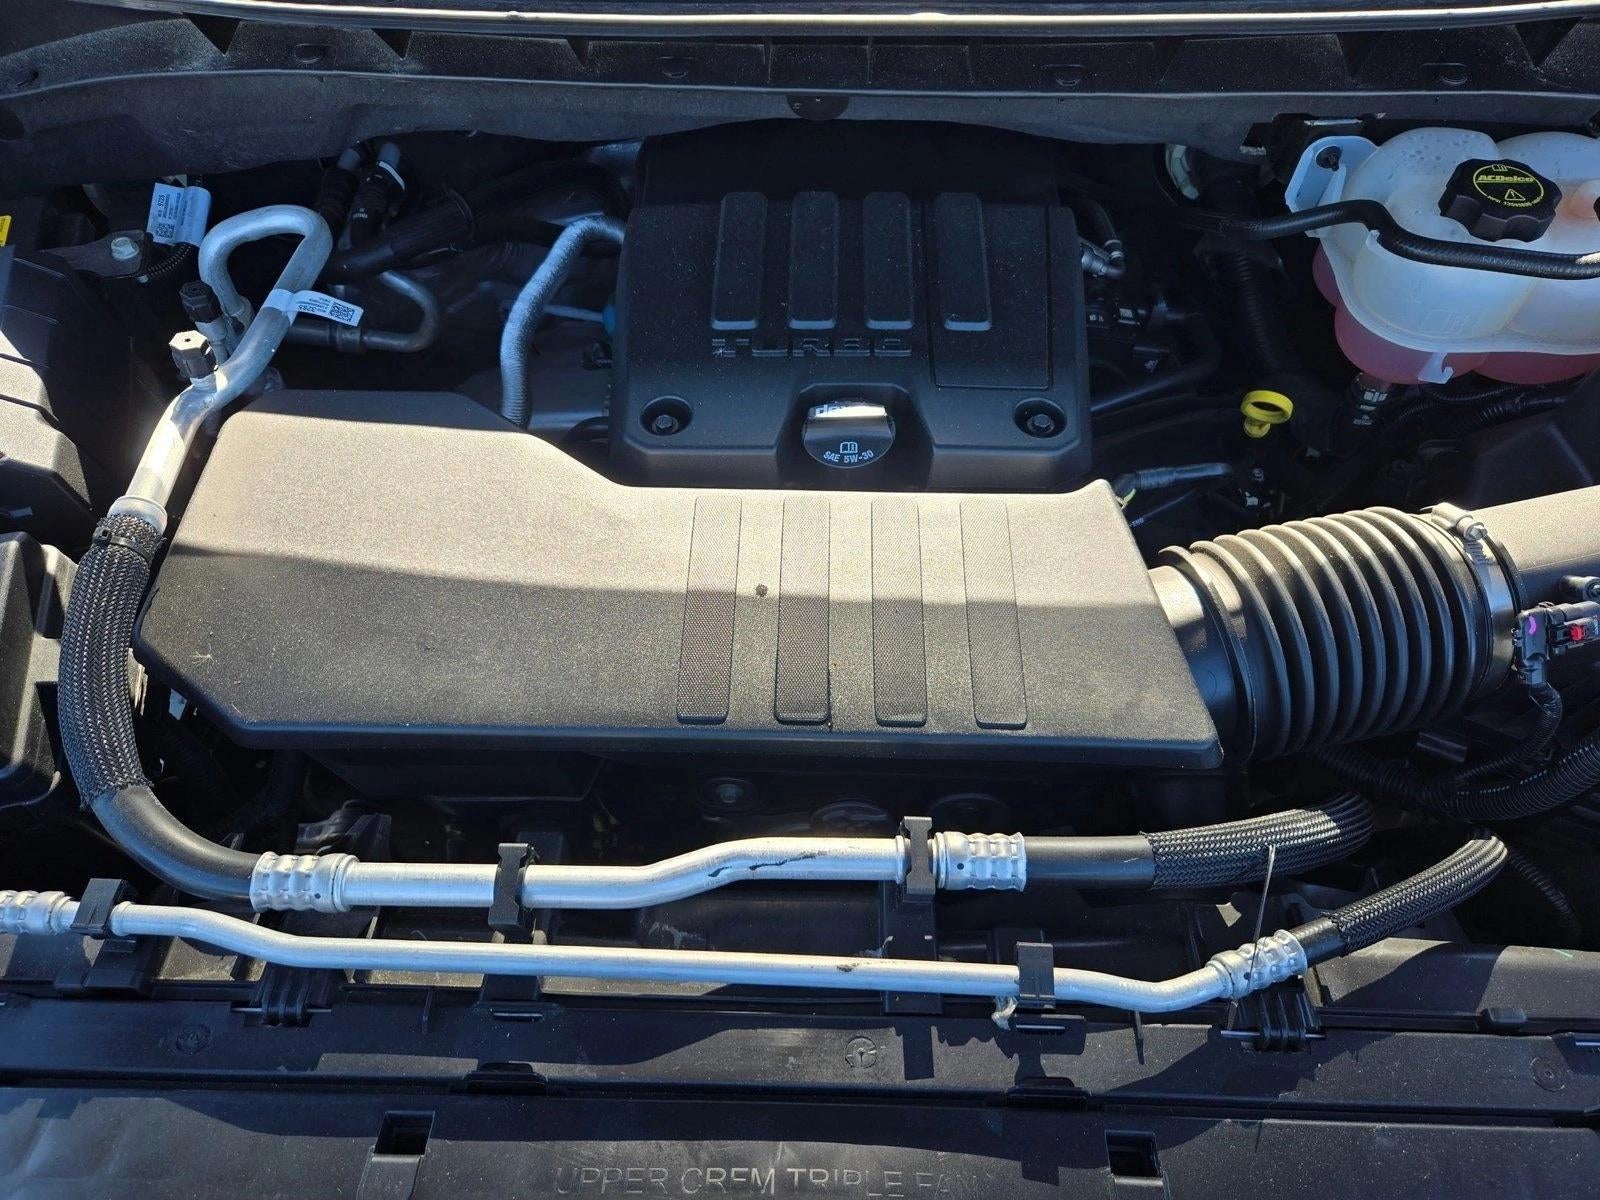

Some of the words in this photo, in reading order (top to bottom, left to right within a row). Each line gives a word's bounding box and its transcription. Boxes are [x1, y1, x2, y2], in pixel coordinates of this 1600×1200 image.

[1477, 174, 1535, 183] ACDelco
[711, 335, 913, 357] TURBO
[823, 450, 841, 462] SAE
[844, 449, 874, 463] 5W-30
[556, 1167, 669, 1194] UPPER
[787, 1168, 905, 1197] TRIPLE
